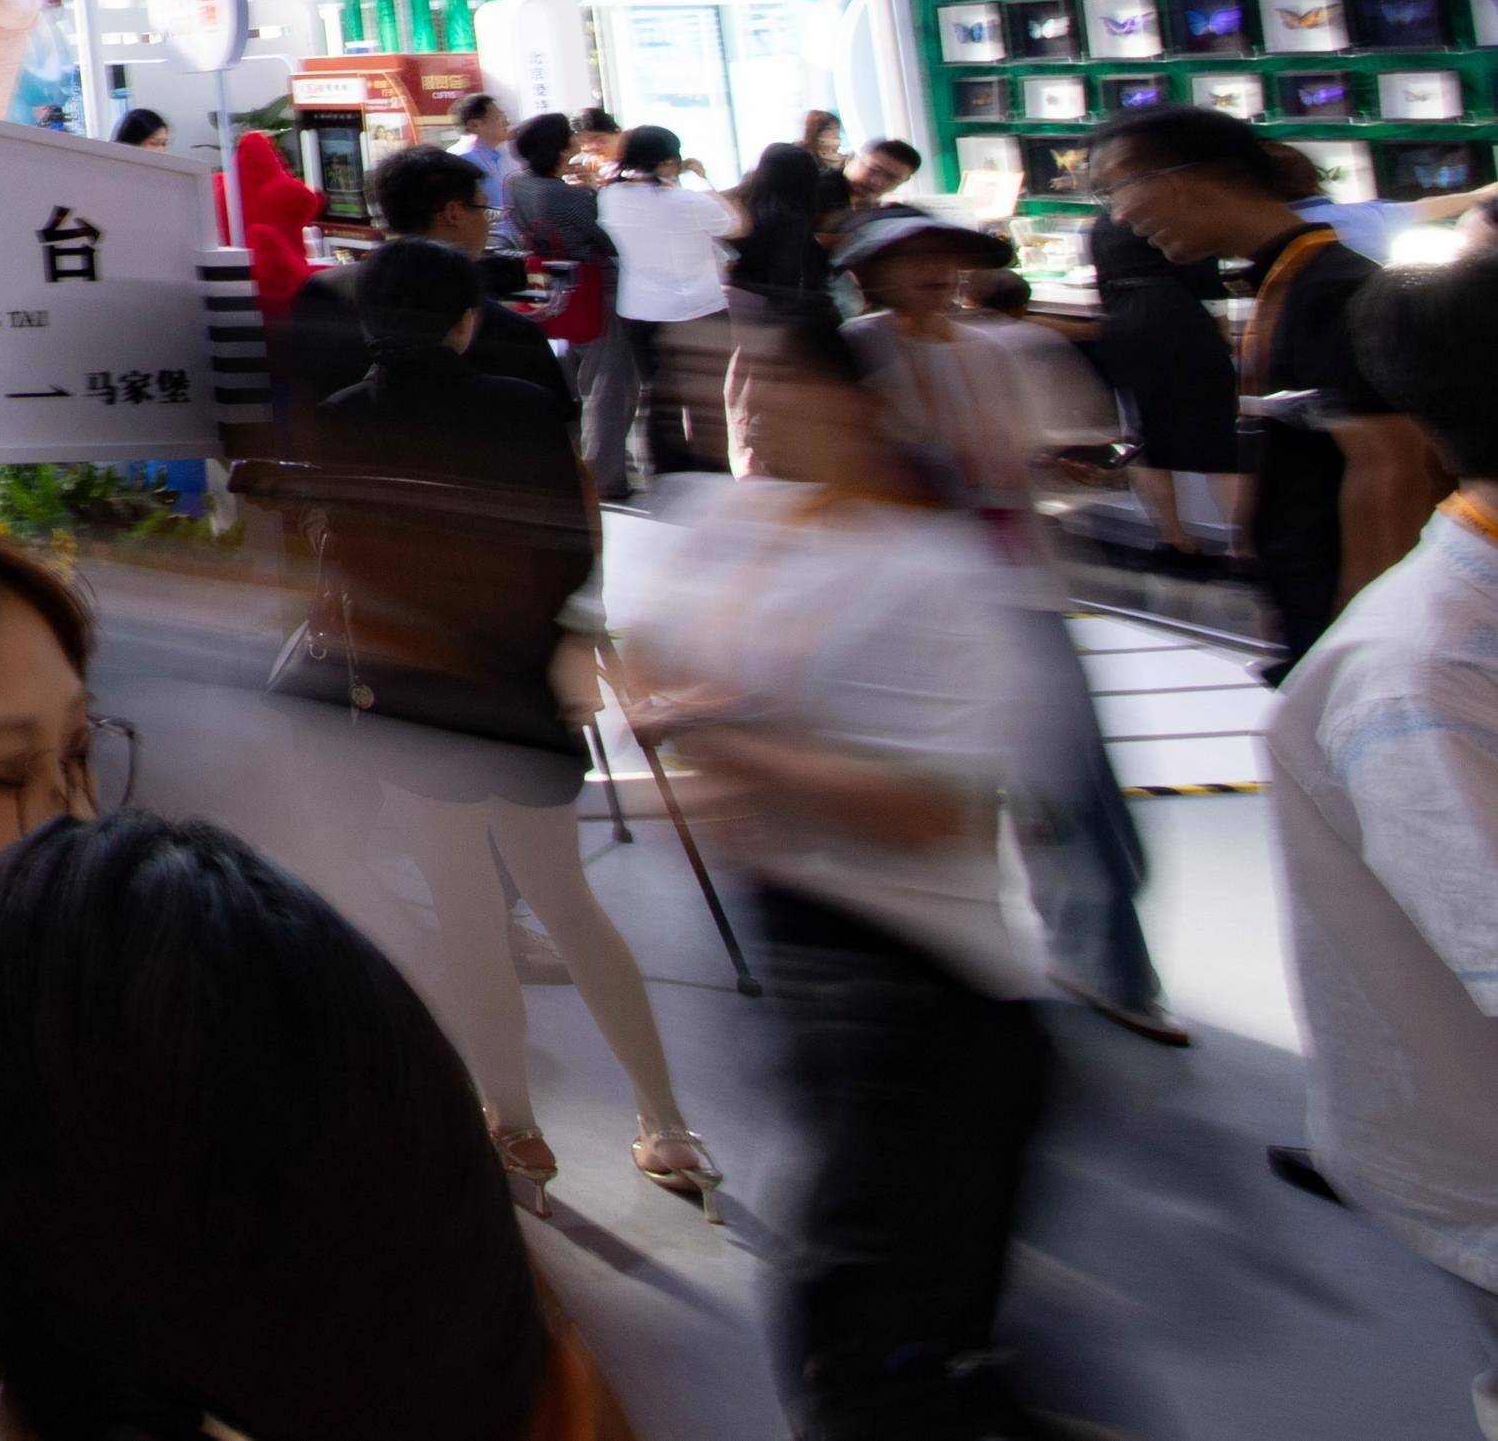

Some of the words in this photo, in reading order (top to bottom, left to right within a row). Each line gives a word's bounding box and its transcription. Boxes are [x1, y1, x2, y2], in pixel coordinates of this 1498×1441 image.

[34, 204, 102, 284] 台
[6, 309, 49, 328] TAI
[84, 367, 193, 406] 马家堡
